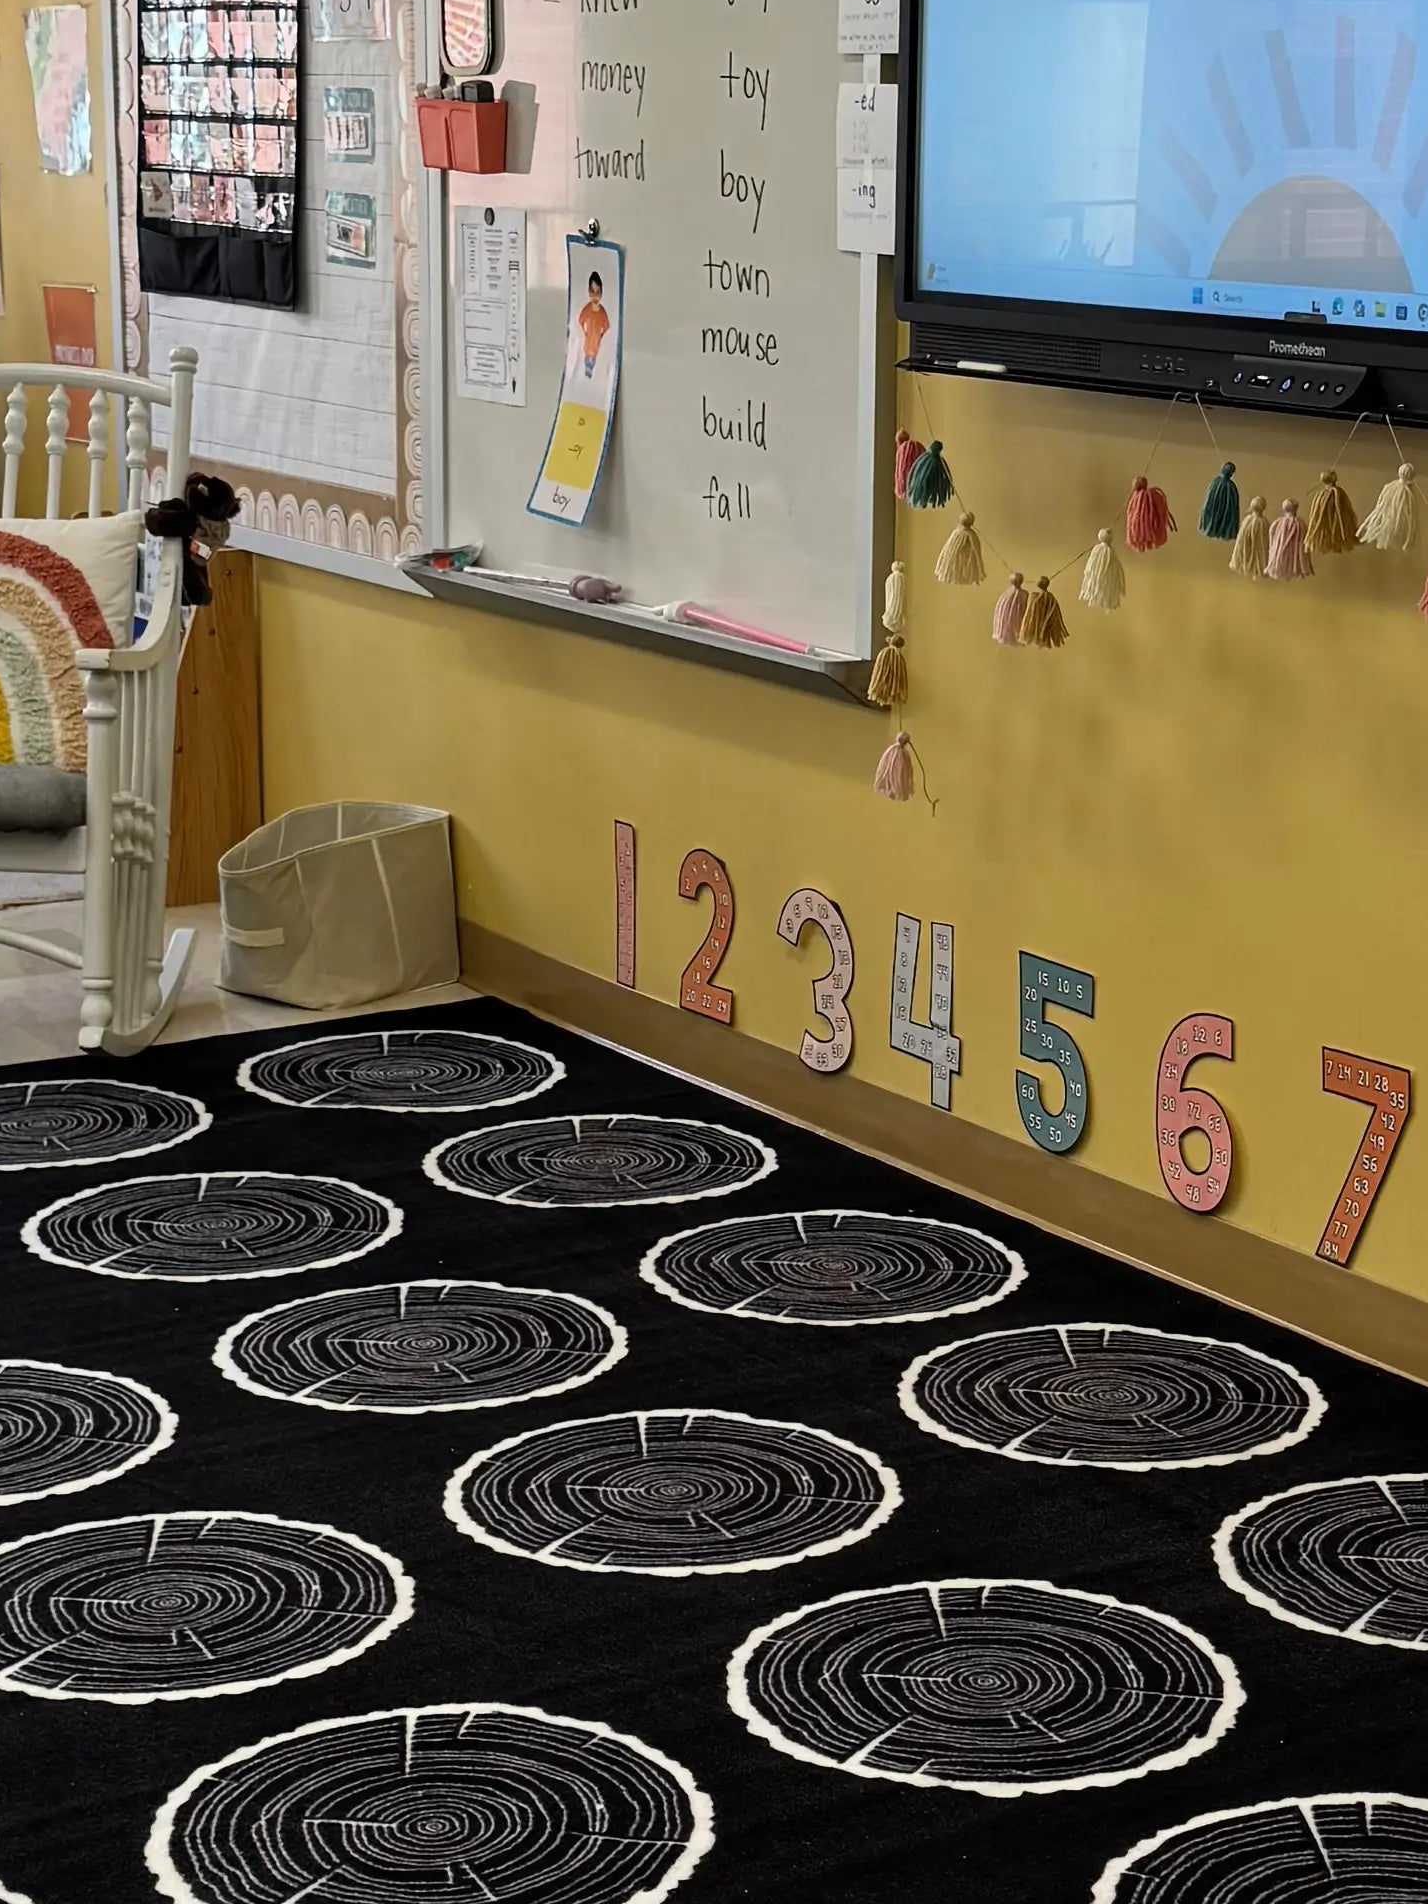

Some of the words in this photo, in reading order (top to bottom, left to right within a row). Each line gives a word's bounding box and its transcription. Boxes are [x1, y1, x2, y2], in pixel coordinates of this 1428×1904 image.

[581, 59, 646, 117] money
[719, 51, 770, 131] toy
[574, 137, 646, 182] toward
[720, 149, 766, 234] boy
[703, 249, 770, 298] town
[701, 325, 780, 366] mouse
[1269, 340, 1326, 358] Promethean
[702, 396, 768, 451] build
[703, 475, 752, 522] fall
[615, 820, 636, 989] 1
[679, 848, 734, 1025] 2
[777, 888, 854, 1073] 3
[890, 911, 961, 1111] 4
[1016, 950, 1095, 1153] 5
[1156, 1013, 1233, 1213] 6
[1315, 1046, 1410, 1265] 7
